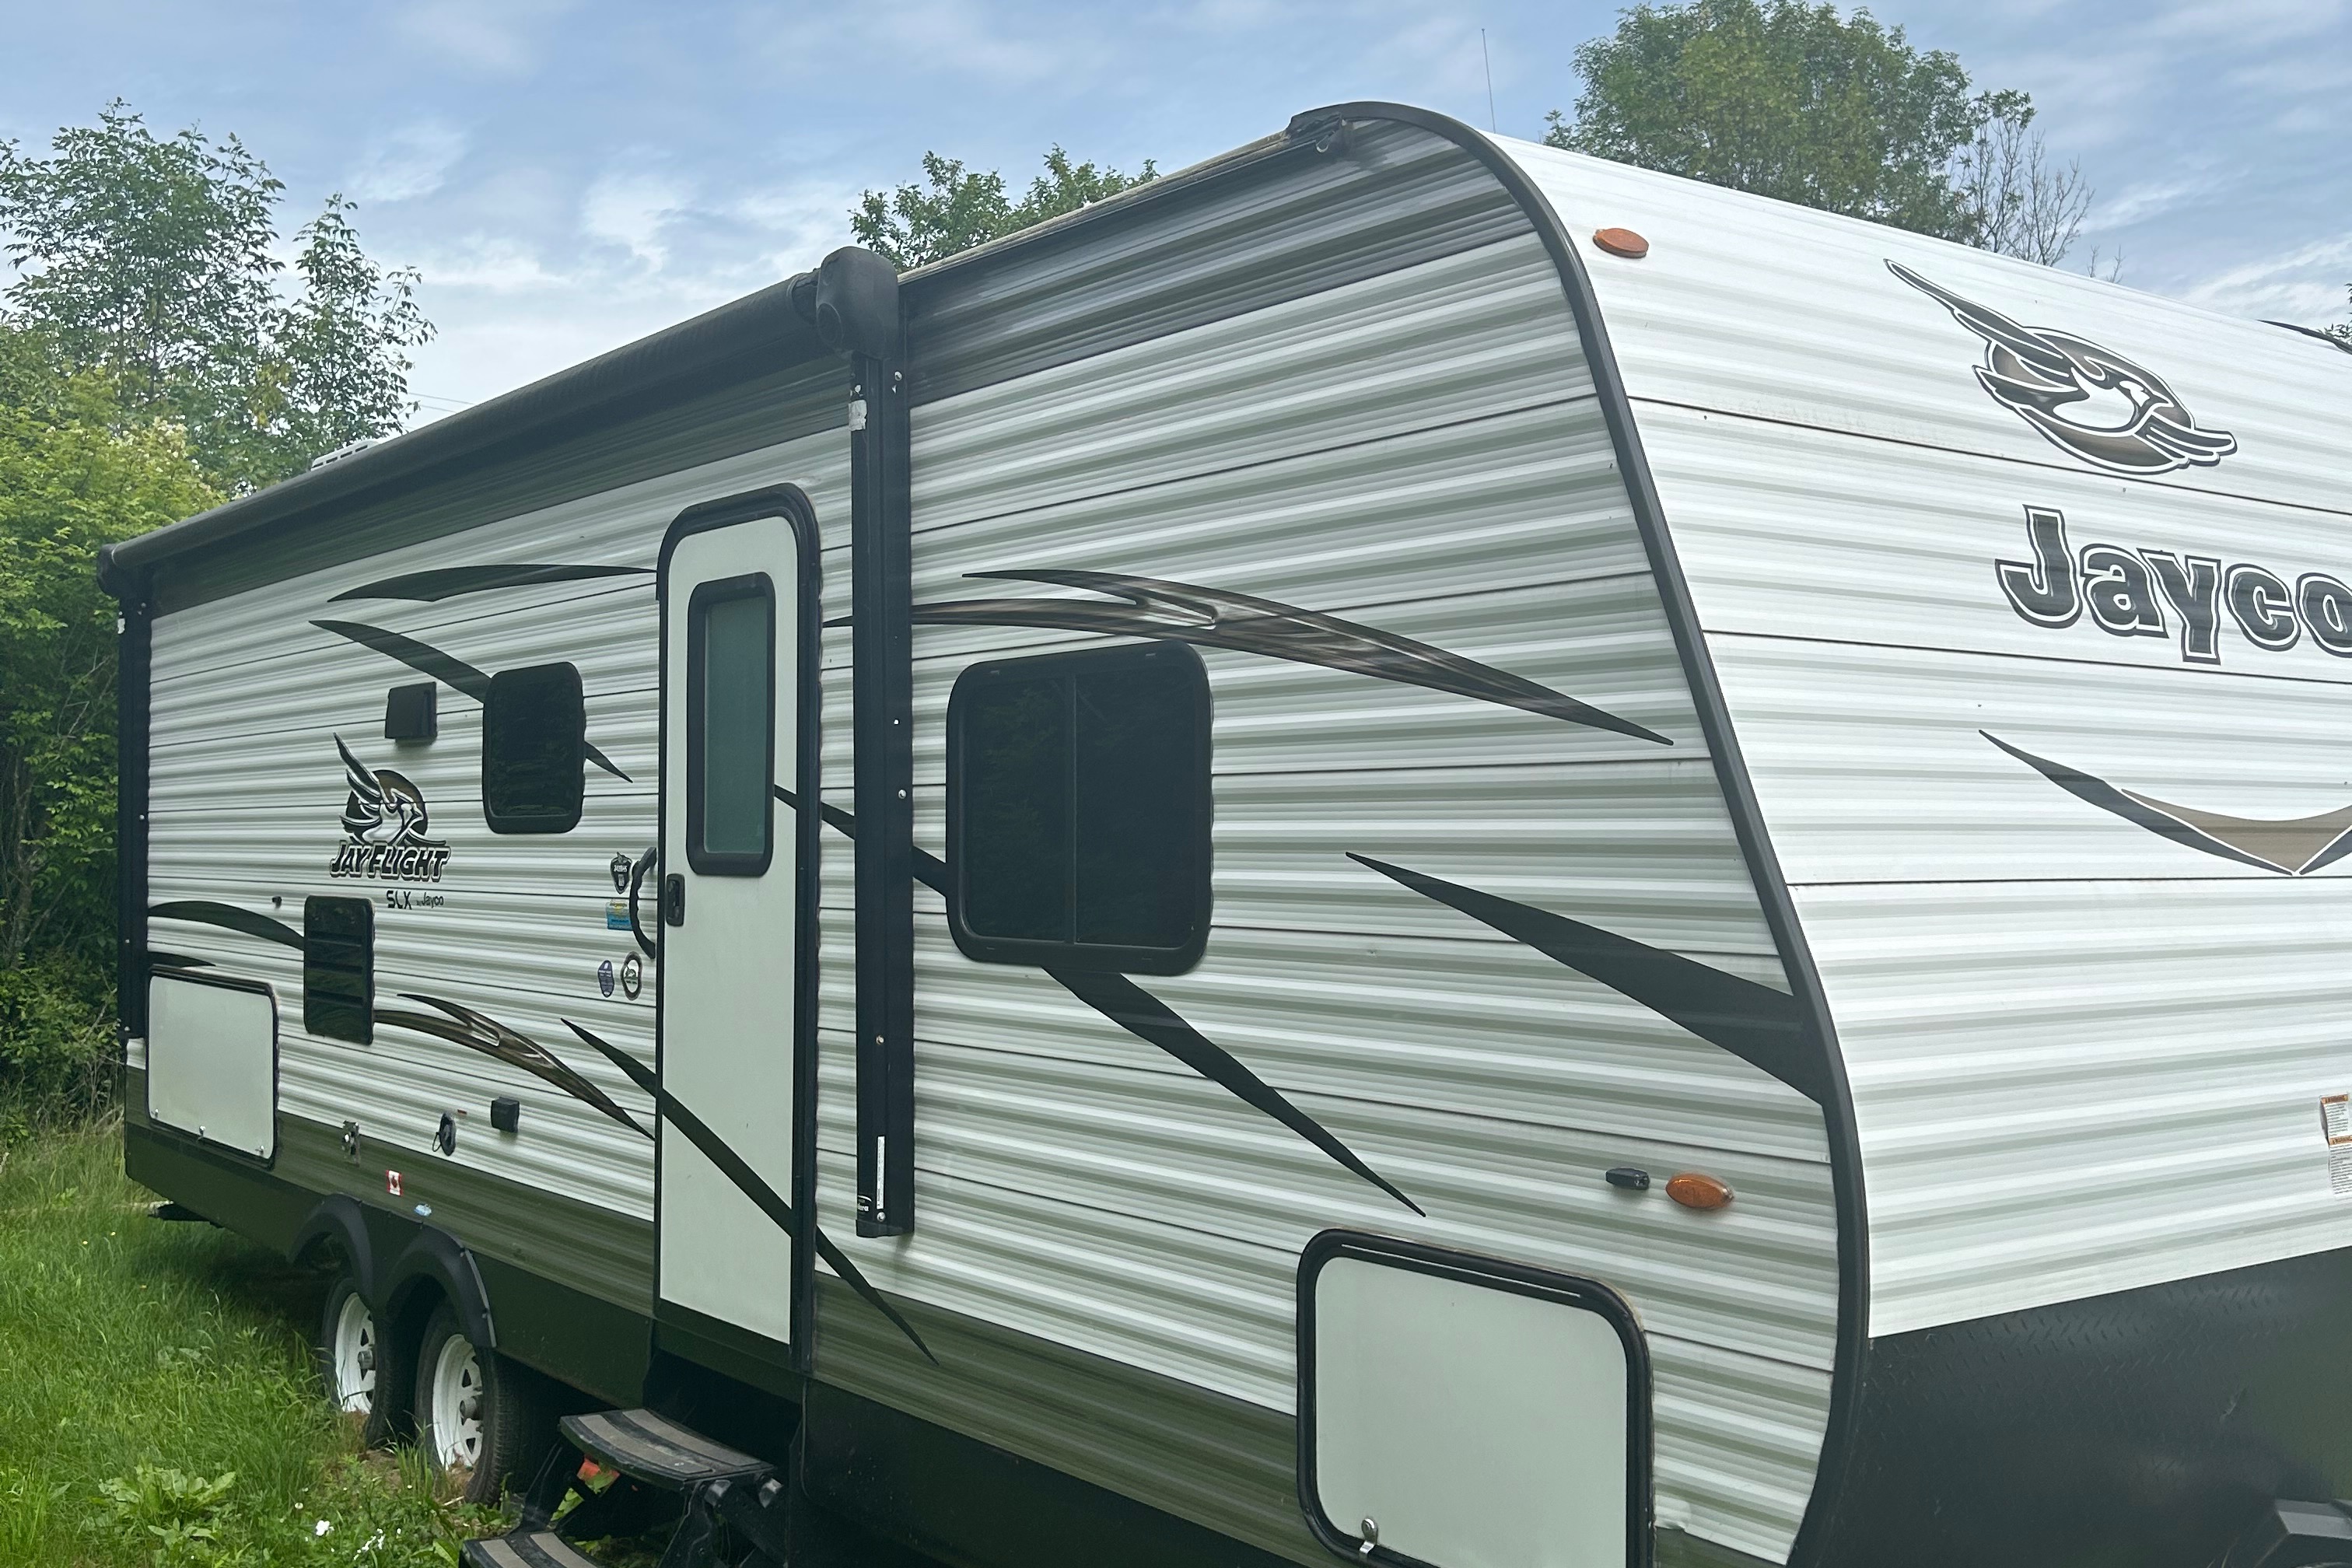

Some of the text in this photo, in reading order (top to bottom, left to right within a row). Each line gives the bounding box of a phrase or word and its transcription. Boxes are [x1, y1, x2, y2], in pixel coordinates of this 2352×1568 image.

[1994, 503, 2352, 666] Jayco
[330, 840, 451, 883] JAY FLIGHT
[386, 890, 412, 910] SLX
